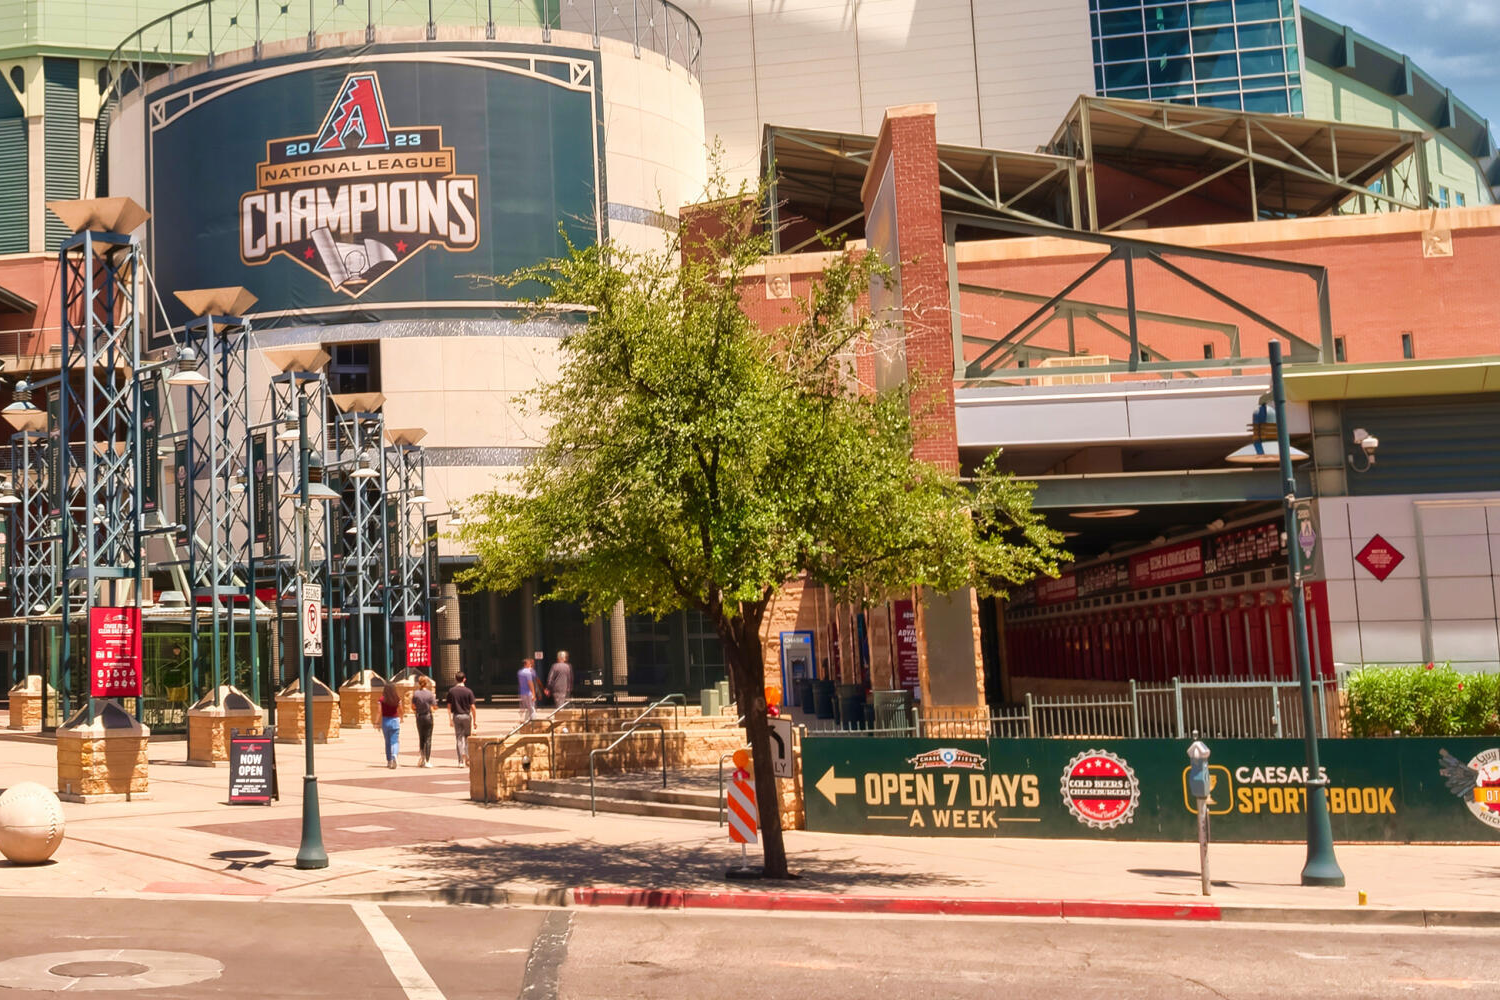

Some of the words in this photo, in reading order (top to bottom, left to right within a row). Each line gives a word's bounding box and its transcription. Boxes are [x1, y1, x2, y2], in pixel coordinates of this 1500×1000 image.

[285, 142, 311, 156] 20
[394, 133, 421, 146] 23
[264, 160, 362, 182] NATIONAL
[366, 156, 446, 171] LEAGUE
[242, 179, 476, 259] CHAMPIONS
[238, 765, 263, 776] OPEN
[240, 754, 262, 764] NOW
[864, 773, 936, 806] OPEN
[943, 774, 960, 807] 7
[969, 774, 1041, 807] DAYS
[1069, 780, 1093, 788] COLD
[1094, 780, 1123, 788] BEERS
[1237, 787, 1397, 814] SPORTBOOK
[909, 809, 925, 828] A
[932, 809, 998, 829] WEEK
